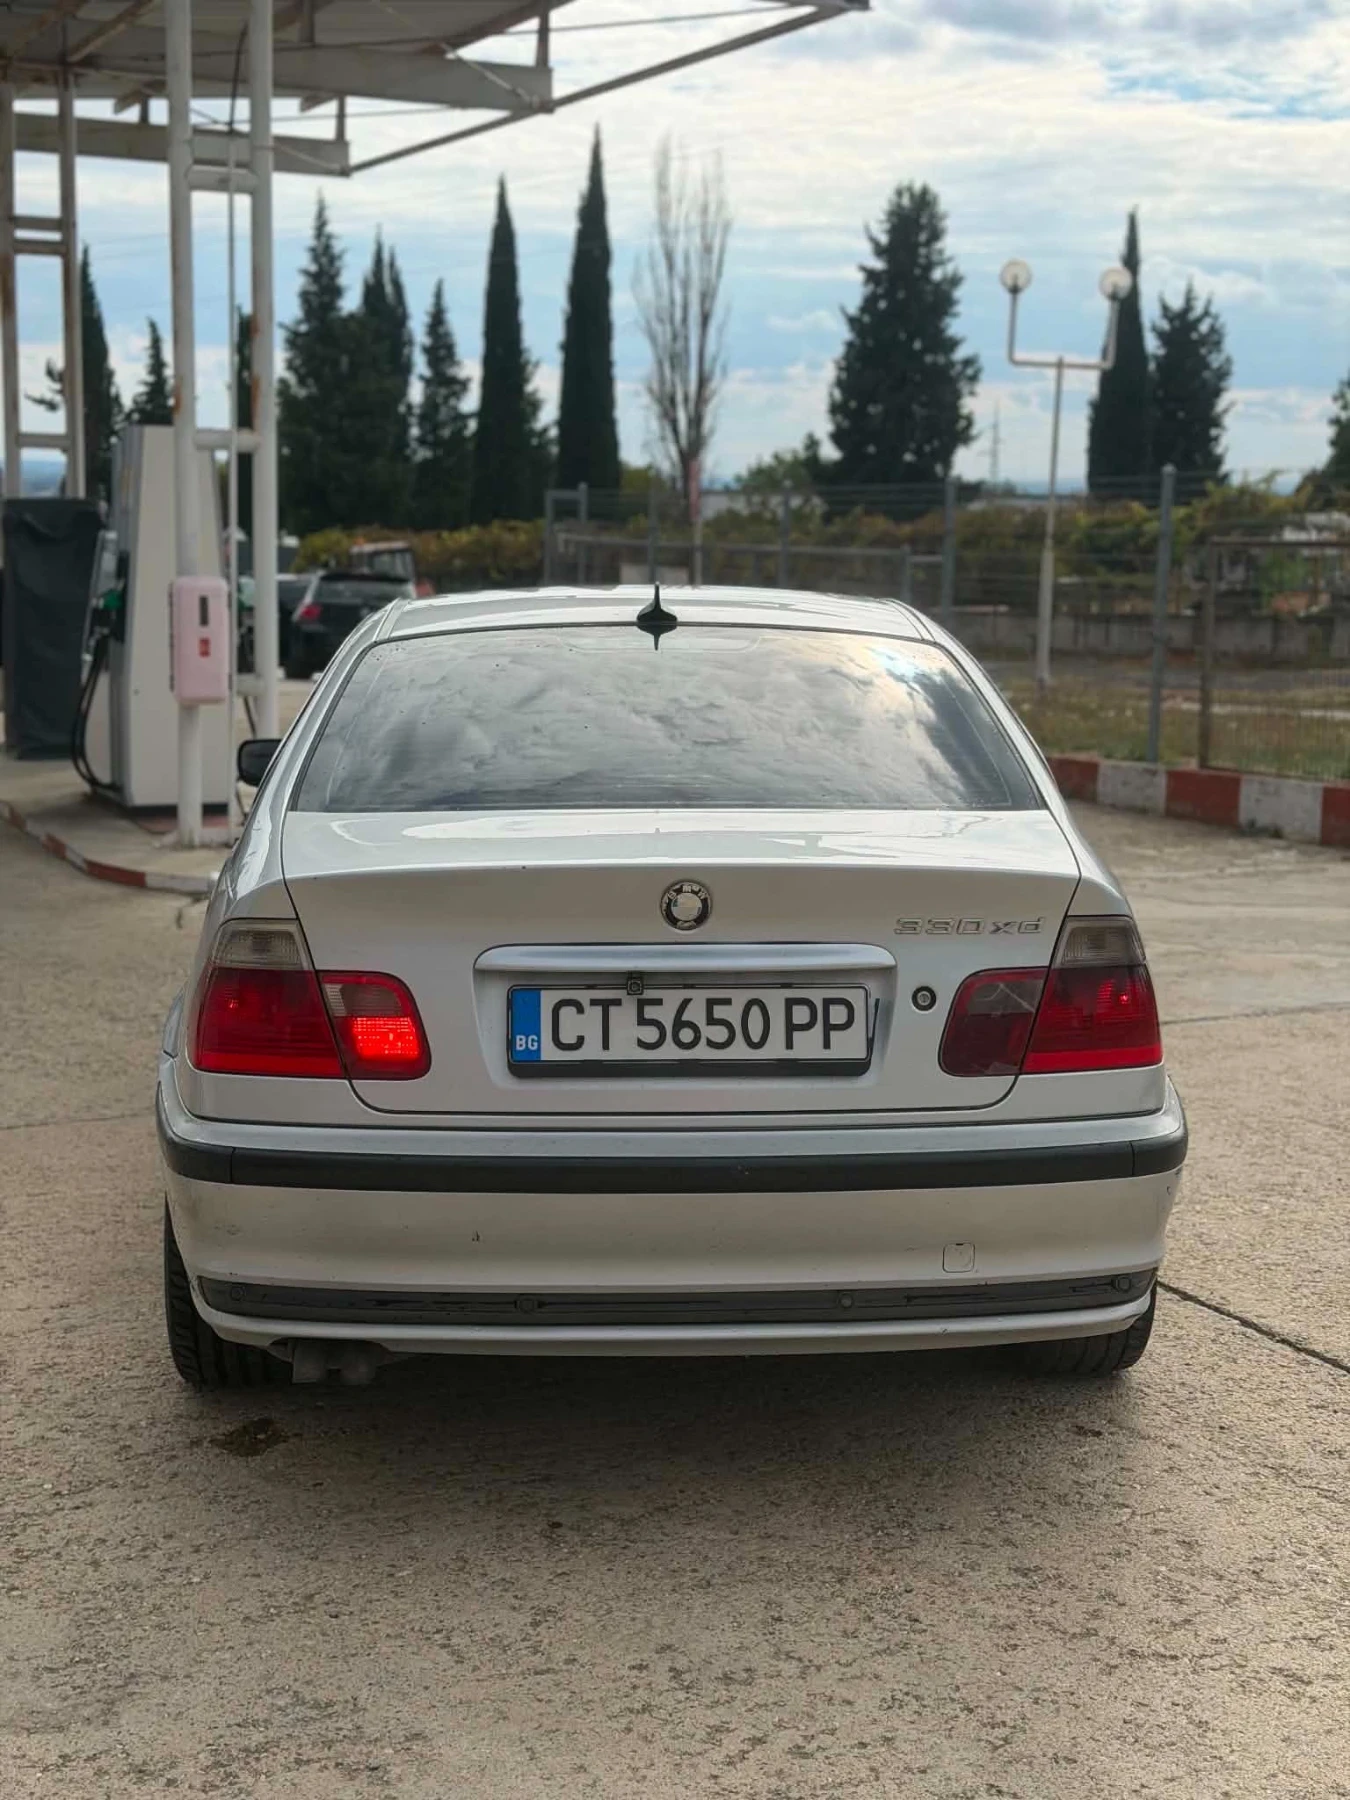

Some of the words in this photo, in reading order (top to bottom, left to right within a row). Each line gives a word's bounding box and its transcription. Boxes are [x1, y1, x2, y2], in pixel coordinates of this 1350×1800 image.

[551, 998, 622, 1051] CT
[636, 998, 771, 1050] 5650
[785, 997, 855, 1050] PP
[515, 1034, 538, 1051] BG
